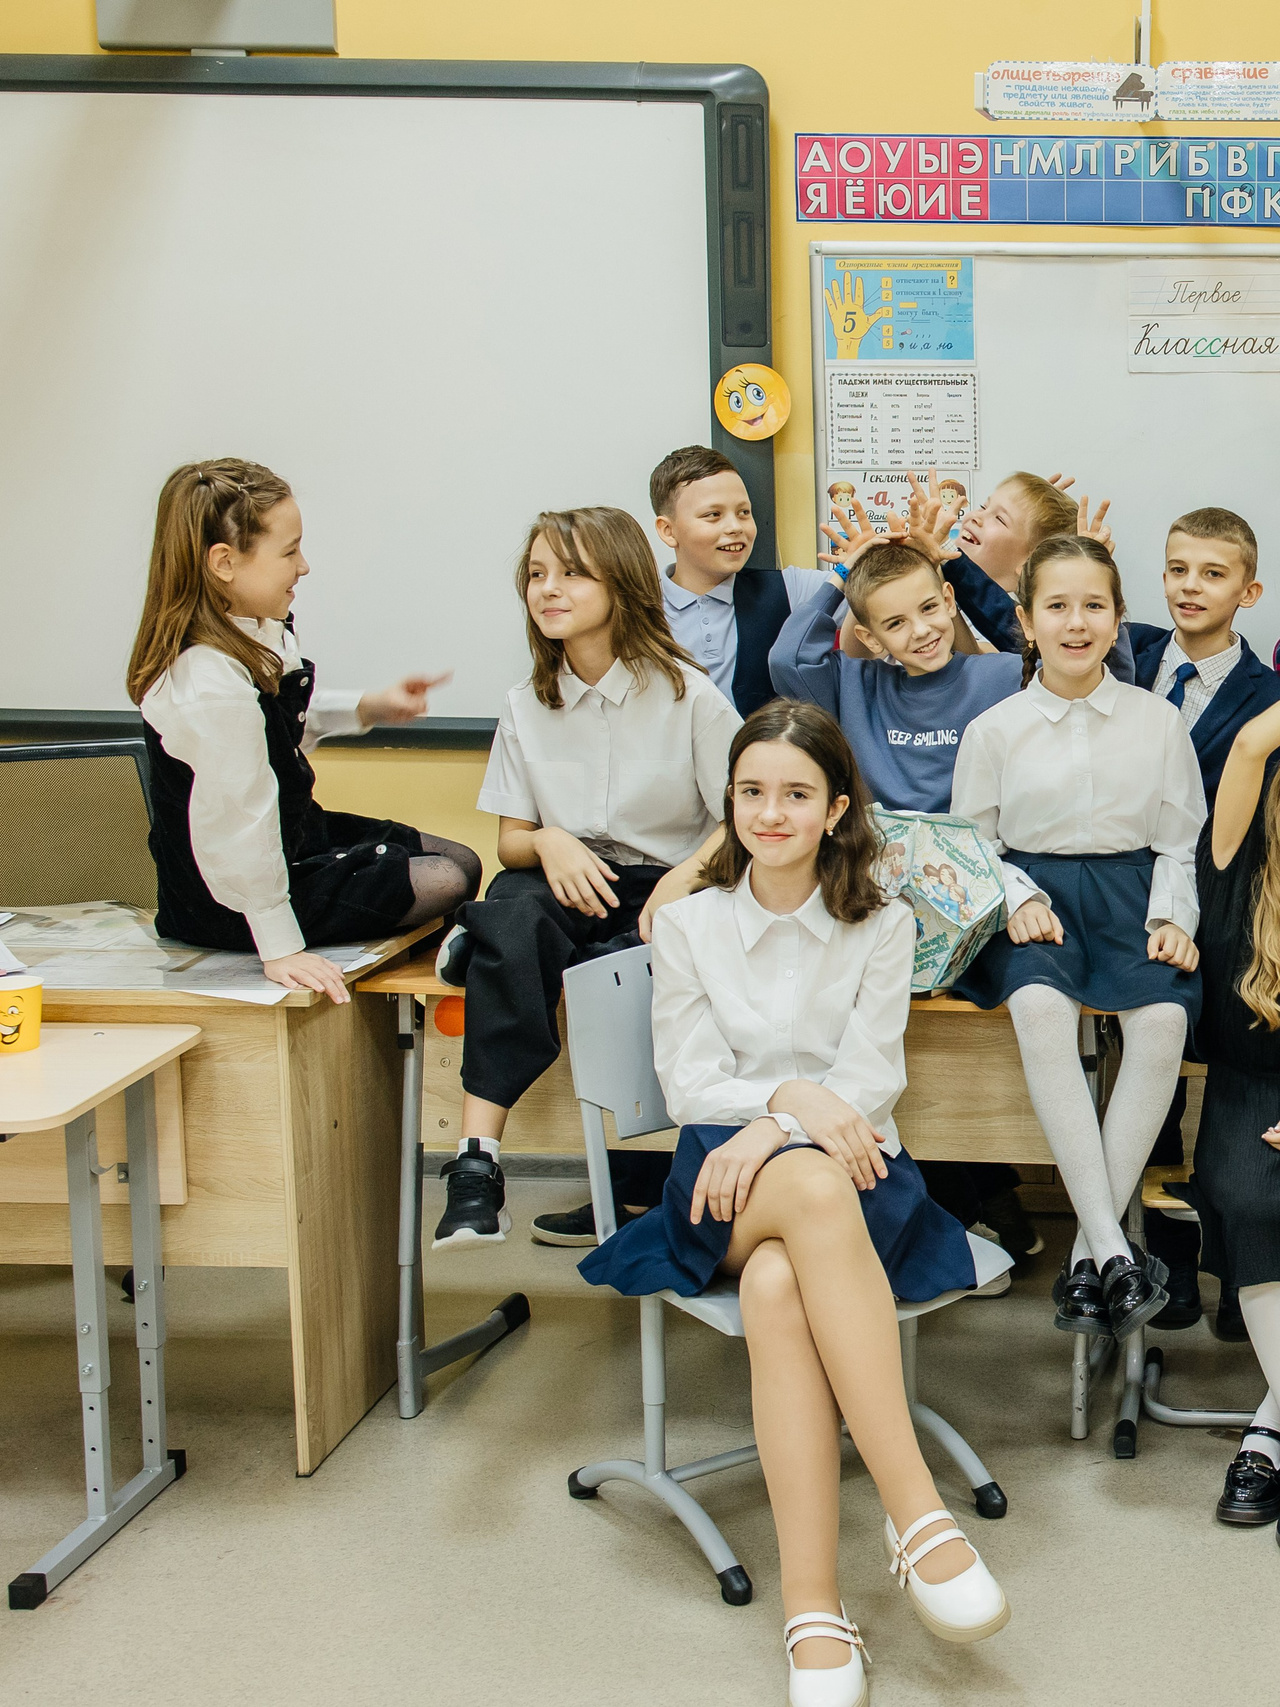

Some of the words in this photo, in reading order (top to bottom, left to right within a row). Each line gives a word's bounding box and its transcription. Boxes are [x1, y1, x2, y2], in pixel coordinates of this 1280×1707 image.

[801, 141, 832, 173] А
[839, 140, 872, 174] О
[880, 141, 907, 173] У
[918, 142, 948, 174] Ы
[958, 142, 983, 174] Э
[993, 142, 1021, 175] Н
[1028, 143, 1064, 175] М
[1070, 143, 1098, 175] Л
[1114, 143, 1136, 176] Р
[1149, 142, 1177, 176] Й
[1188, 145, 1210, 177] Б
[1227, 145, 1249, 177] В
[805, 182, 828, 214] Я
[845, 179, 866, 215] Ё
[878, 183, 912, 216] Ю
[918, 184, 946, 216] И
[960, 184, 982, 216] Е
[1186, 187, 1211, 218] П
[1220, 187, 1253, 218] Ф
[1167, 280, 1242, 313] Первое
[842, 311, 857, 334] 5
[1133, 322, 1279, 356] Классная
[869, 474, 930, 483] склонеие
[886, 729, 912, 745] KEEP
[913, 729, 959, 746] SMILING
